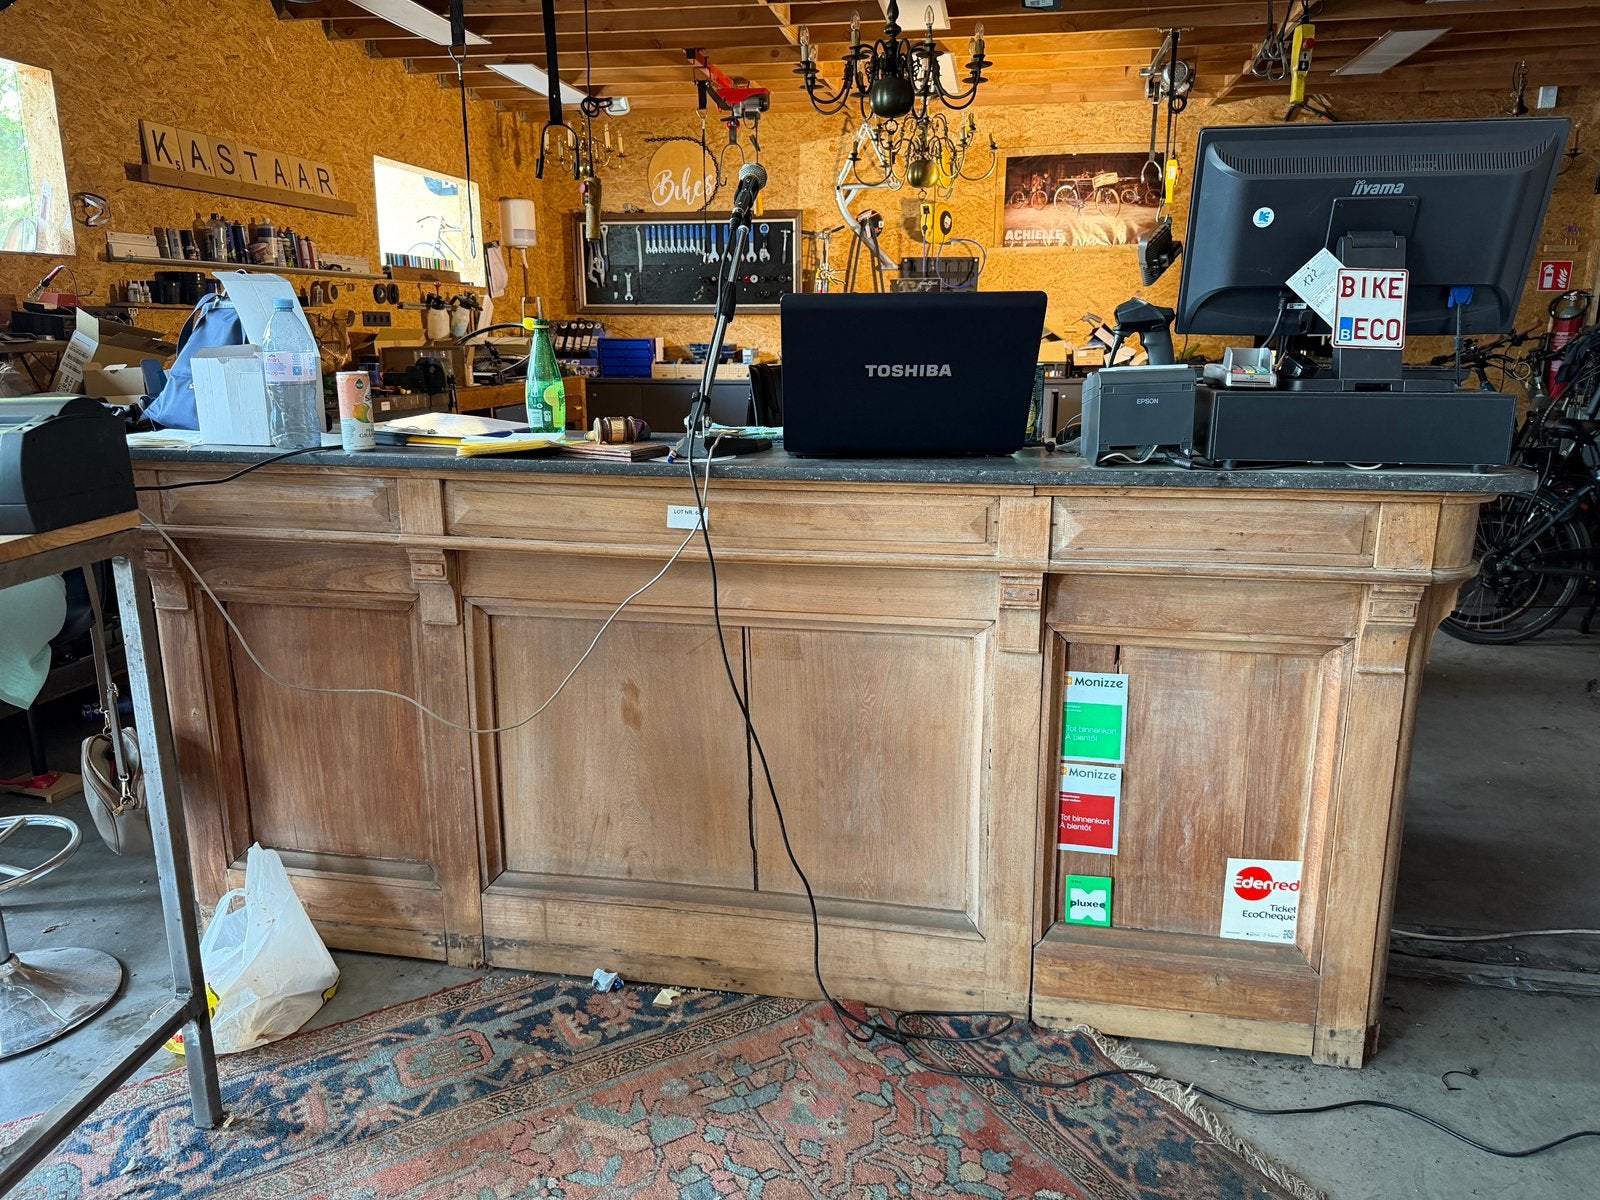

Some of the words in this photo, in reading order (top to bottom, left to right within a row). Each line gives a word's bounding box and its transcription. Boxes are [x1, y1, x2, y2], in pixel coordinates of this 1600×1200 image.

[152, 129, 334, 196] KASTAAR
[652, 167, 716, 206] Bikes
[1352, 180, 1405, 195] iiyama
[1340, 276, 1404, 299] BIKE
[1340, 329, 1351, 340] B
[1353, 318, 1401, 341] ECO
[864, 364, 952, 377] TOSHIBA
[1074, 677, 1124, 688] Monizze
[1066, 724, 1077, 733] Tot
[1078, 726, 1117, 735] binnenkort
[1068, 768, 1117, 781] Monizze
[1060, 813, 1071, 821] Tot
[1072, 815, 1110, 825] binnenkort
[1067, 823, 1092, 831] bientôt
[1233, 875, 1301, 892] Edenred
[1070, 899, 1106, 908] pluxee
[1270, 904, 1297, 913] Ticket
[1242, 909, 1296, 922] EcoCheque
